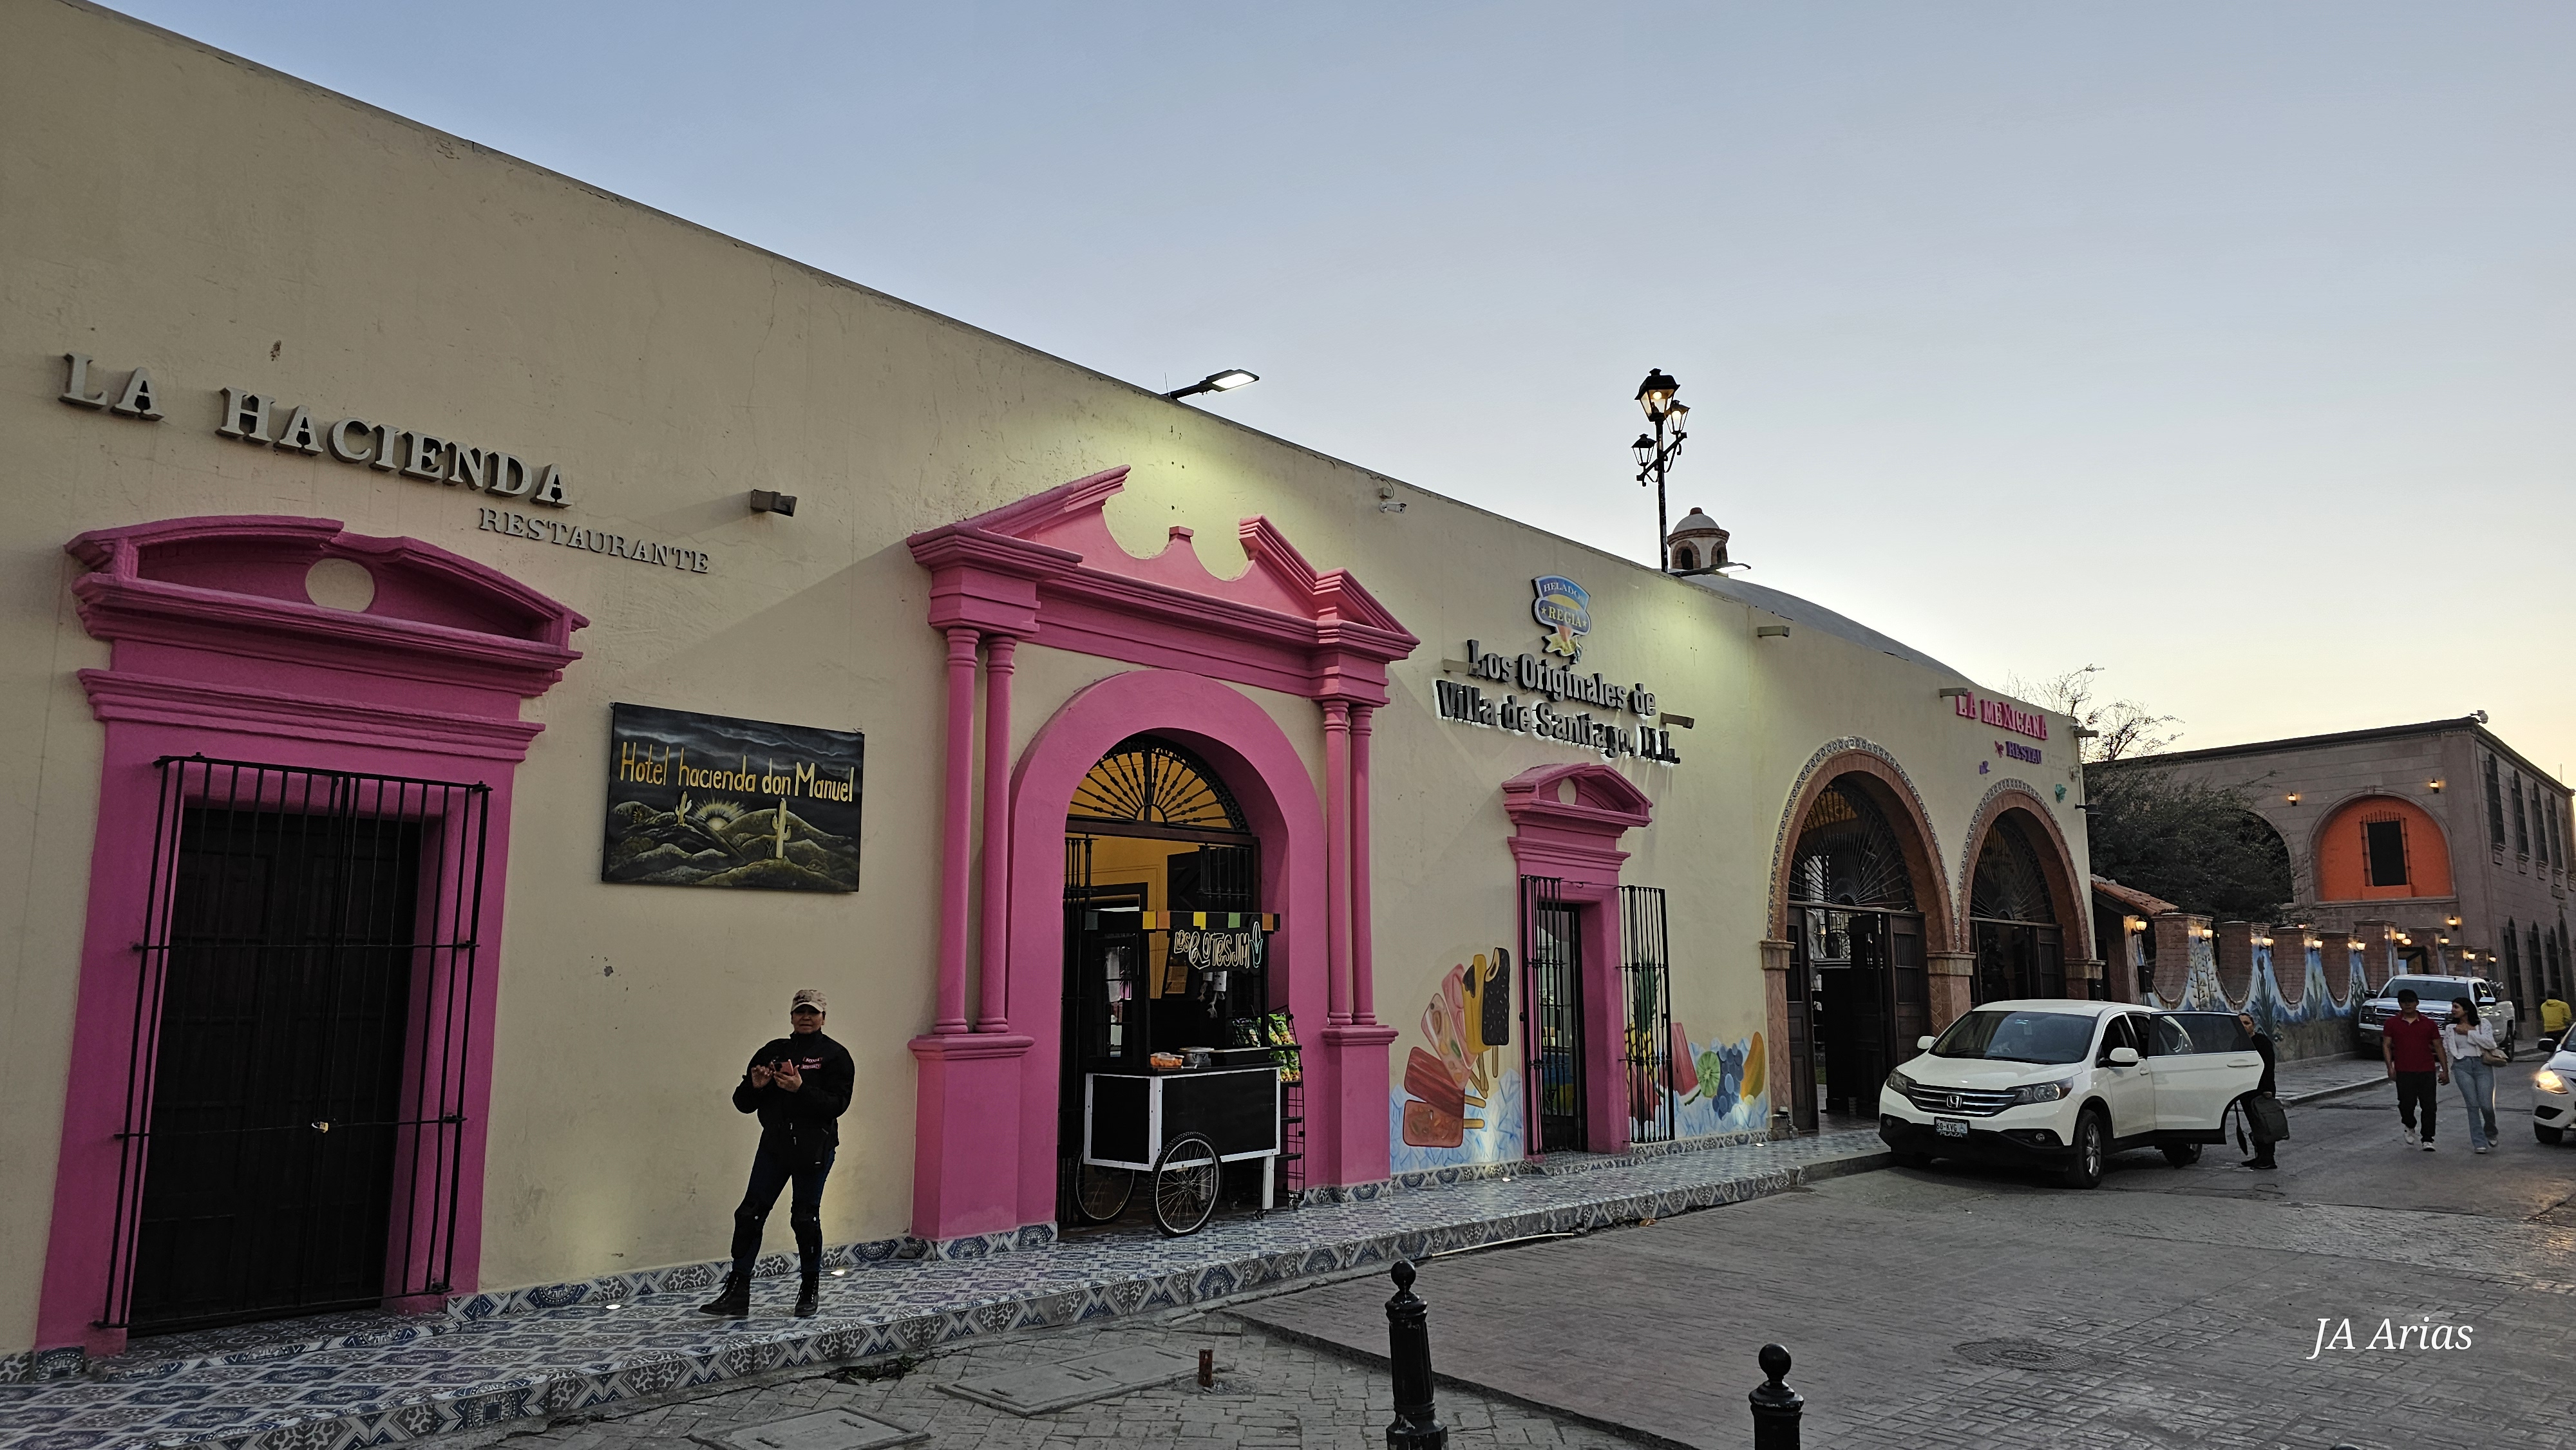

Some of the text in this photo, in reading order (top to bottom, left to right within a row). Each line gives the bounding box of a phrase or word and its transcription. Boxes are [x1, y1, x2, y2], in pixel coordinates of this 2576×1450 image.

[59, 351, 572, 508] LA HACIENDA
[478, 507, 709, 574] RESTAURANTE
[1544, 582, 1584, 604] HELADOS
[1548, 606, 1582, 627] REGIA
[1467, 639, 1656, 716] Los Originales de
[1436, 680, 1497, 726] Villa
[1501, 695, 1532, 733] de
[1955, 692, 2049, 740] LA MEXICANA
[620, 742, 855, 802] Hotel hacienda don Manuel
[2005, 740, 2041, 764] RESTAU
